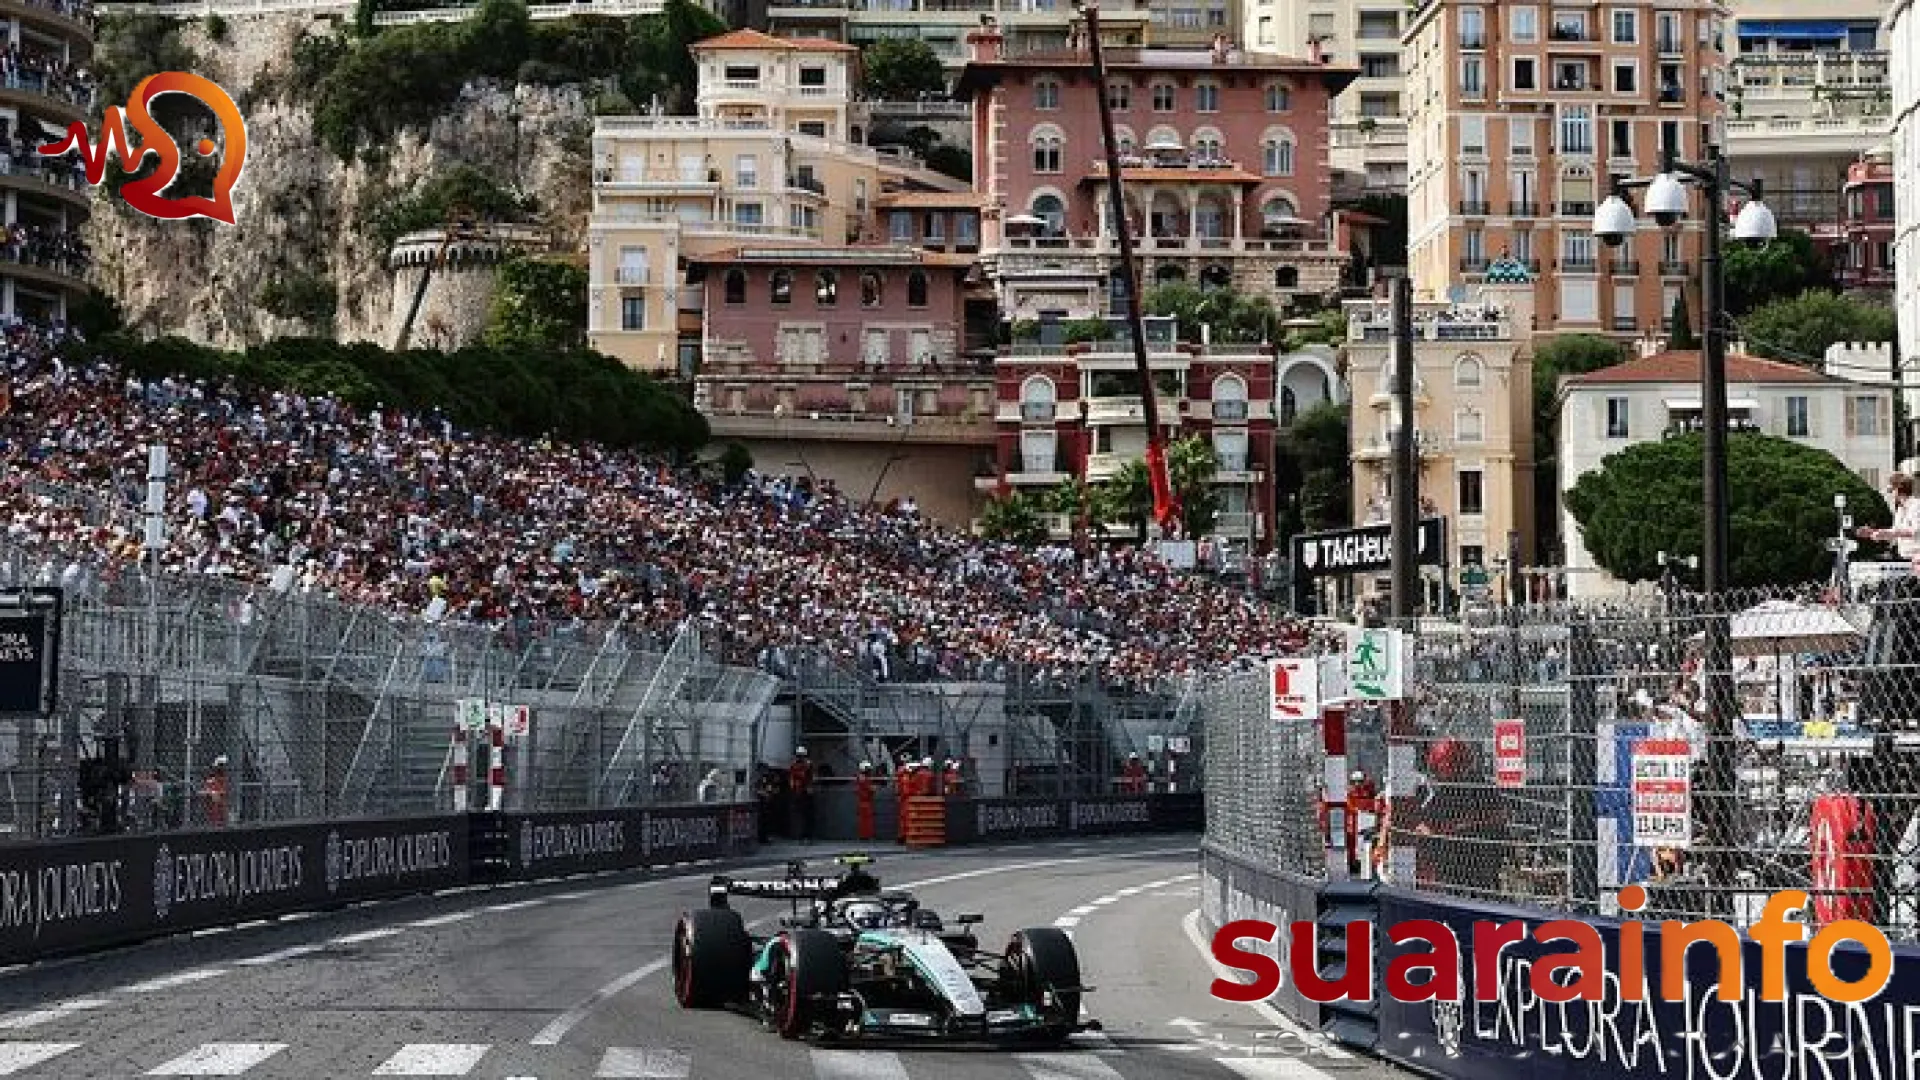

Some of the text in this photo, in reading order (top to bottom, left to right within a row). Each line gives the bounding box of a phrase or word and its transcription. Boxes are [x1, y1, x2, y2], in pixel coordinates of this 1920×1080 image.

[175, 845, 302, 904] EXPLORA JOURNEYS
[343, 835, 396, 881] EXPLORA
[33, 860, 122, 940] JOURNEYS
